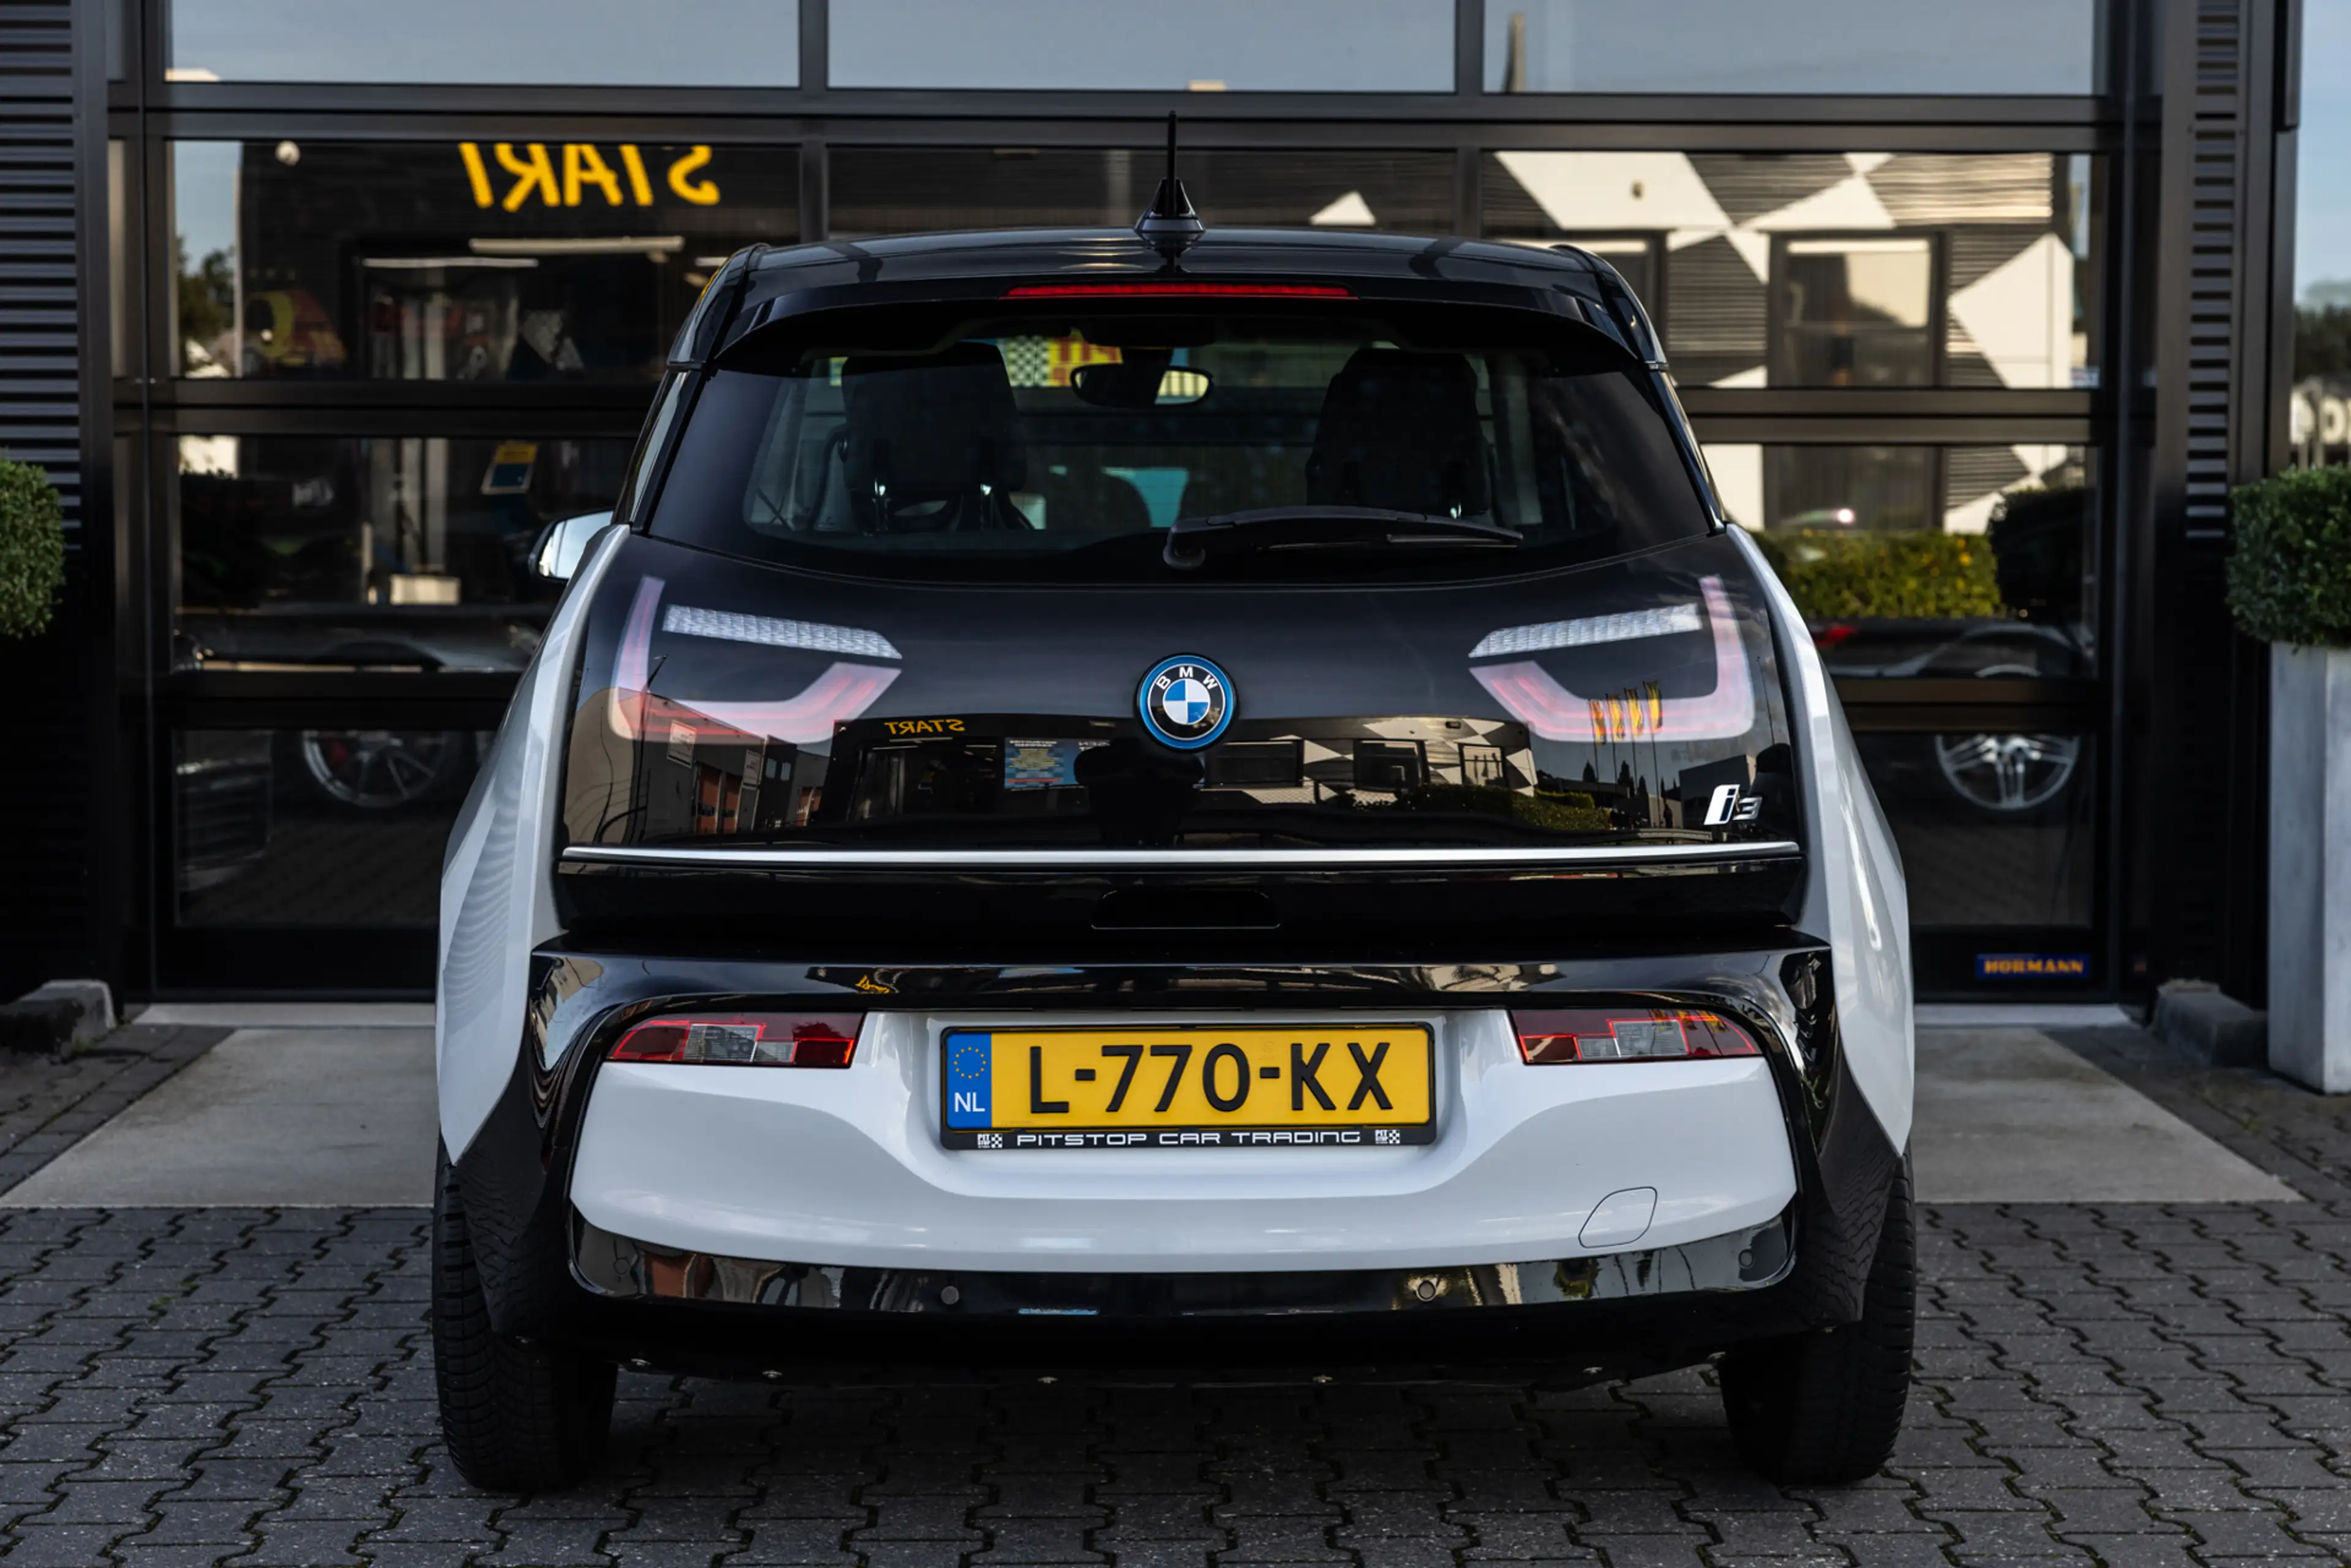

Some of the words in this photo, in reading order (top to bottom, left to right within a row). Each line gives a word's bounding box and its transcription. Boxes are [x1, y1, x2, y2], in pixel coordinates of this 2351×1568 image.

[1156, 666, 1218, 690] BMW
[1704, 784, 1763, 825] i3
[1030, 1043, 1393, 1113] L-770-KX
[954, 1092, 985, 1112] NL
[1017, 1134, 1147, 1146] PITSTOP
[1159, 1133, 1221, 1144] CAR
[1231, 1131, 1360, 1144] TRADING
